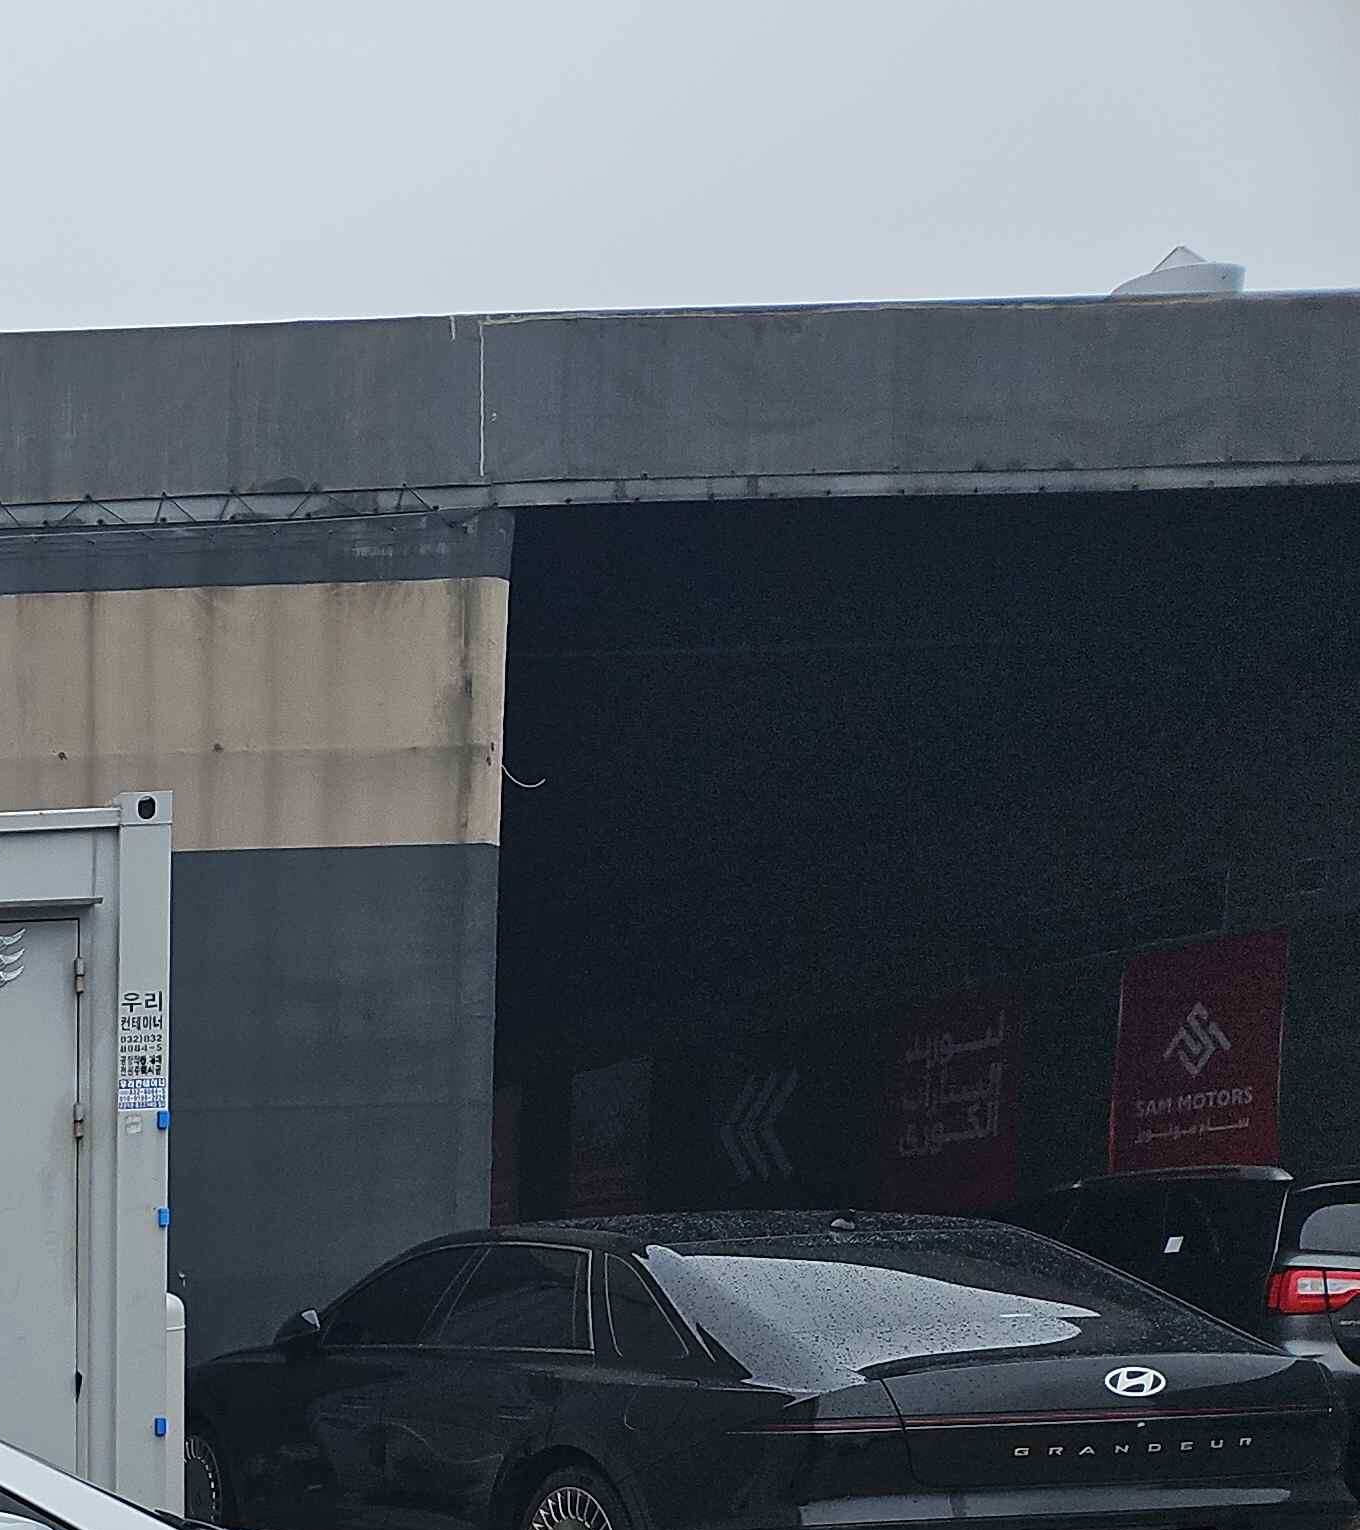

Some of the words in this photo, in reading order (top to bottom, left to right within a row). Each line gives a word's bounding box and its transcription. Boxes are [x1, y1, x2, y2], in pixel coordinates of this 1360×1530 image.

[121, 990, 163, 1013] 우리
[120, 1015, 163, 1031] 컨테이너
[1137, 1097, 1172, 1118] SAM
[1178, 1086, 1254, 1111] MOTORS
[1013, 1436, 1253, 1457] GRANDEUR
